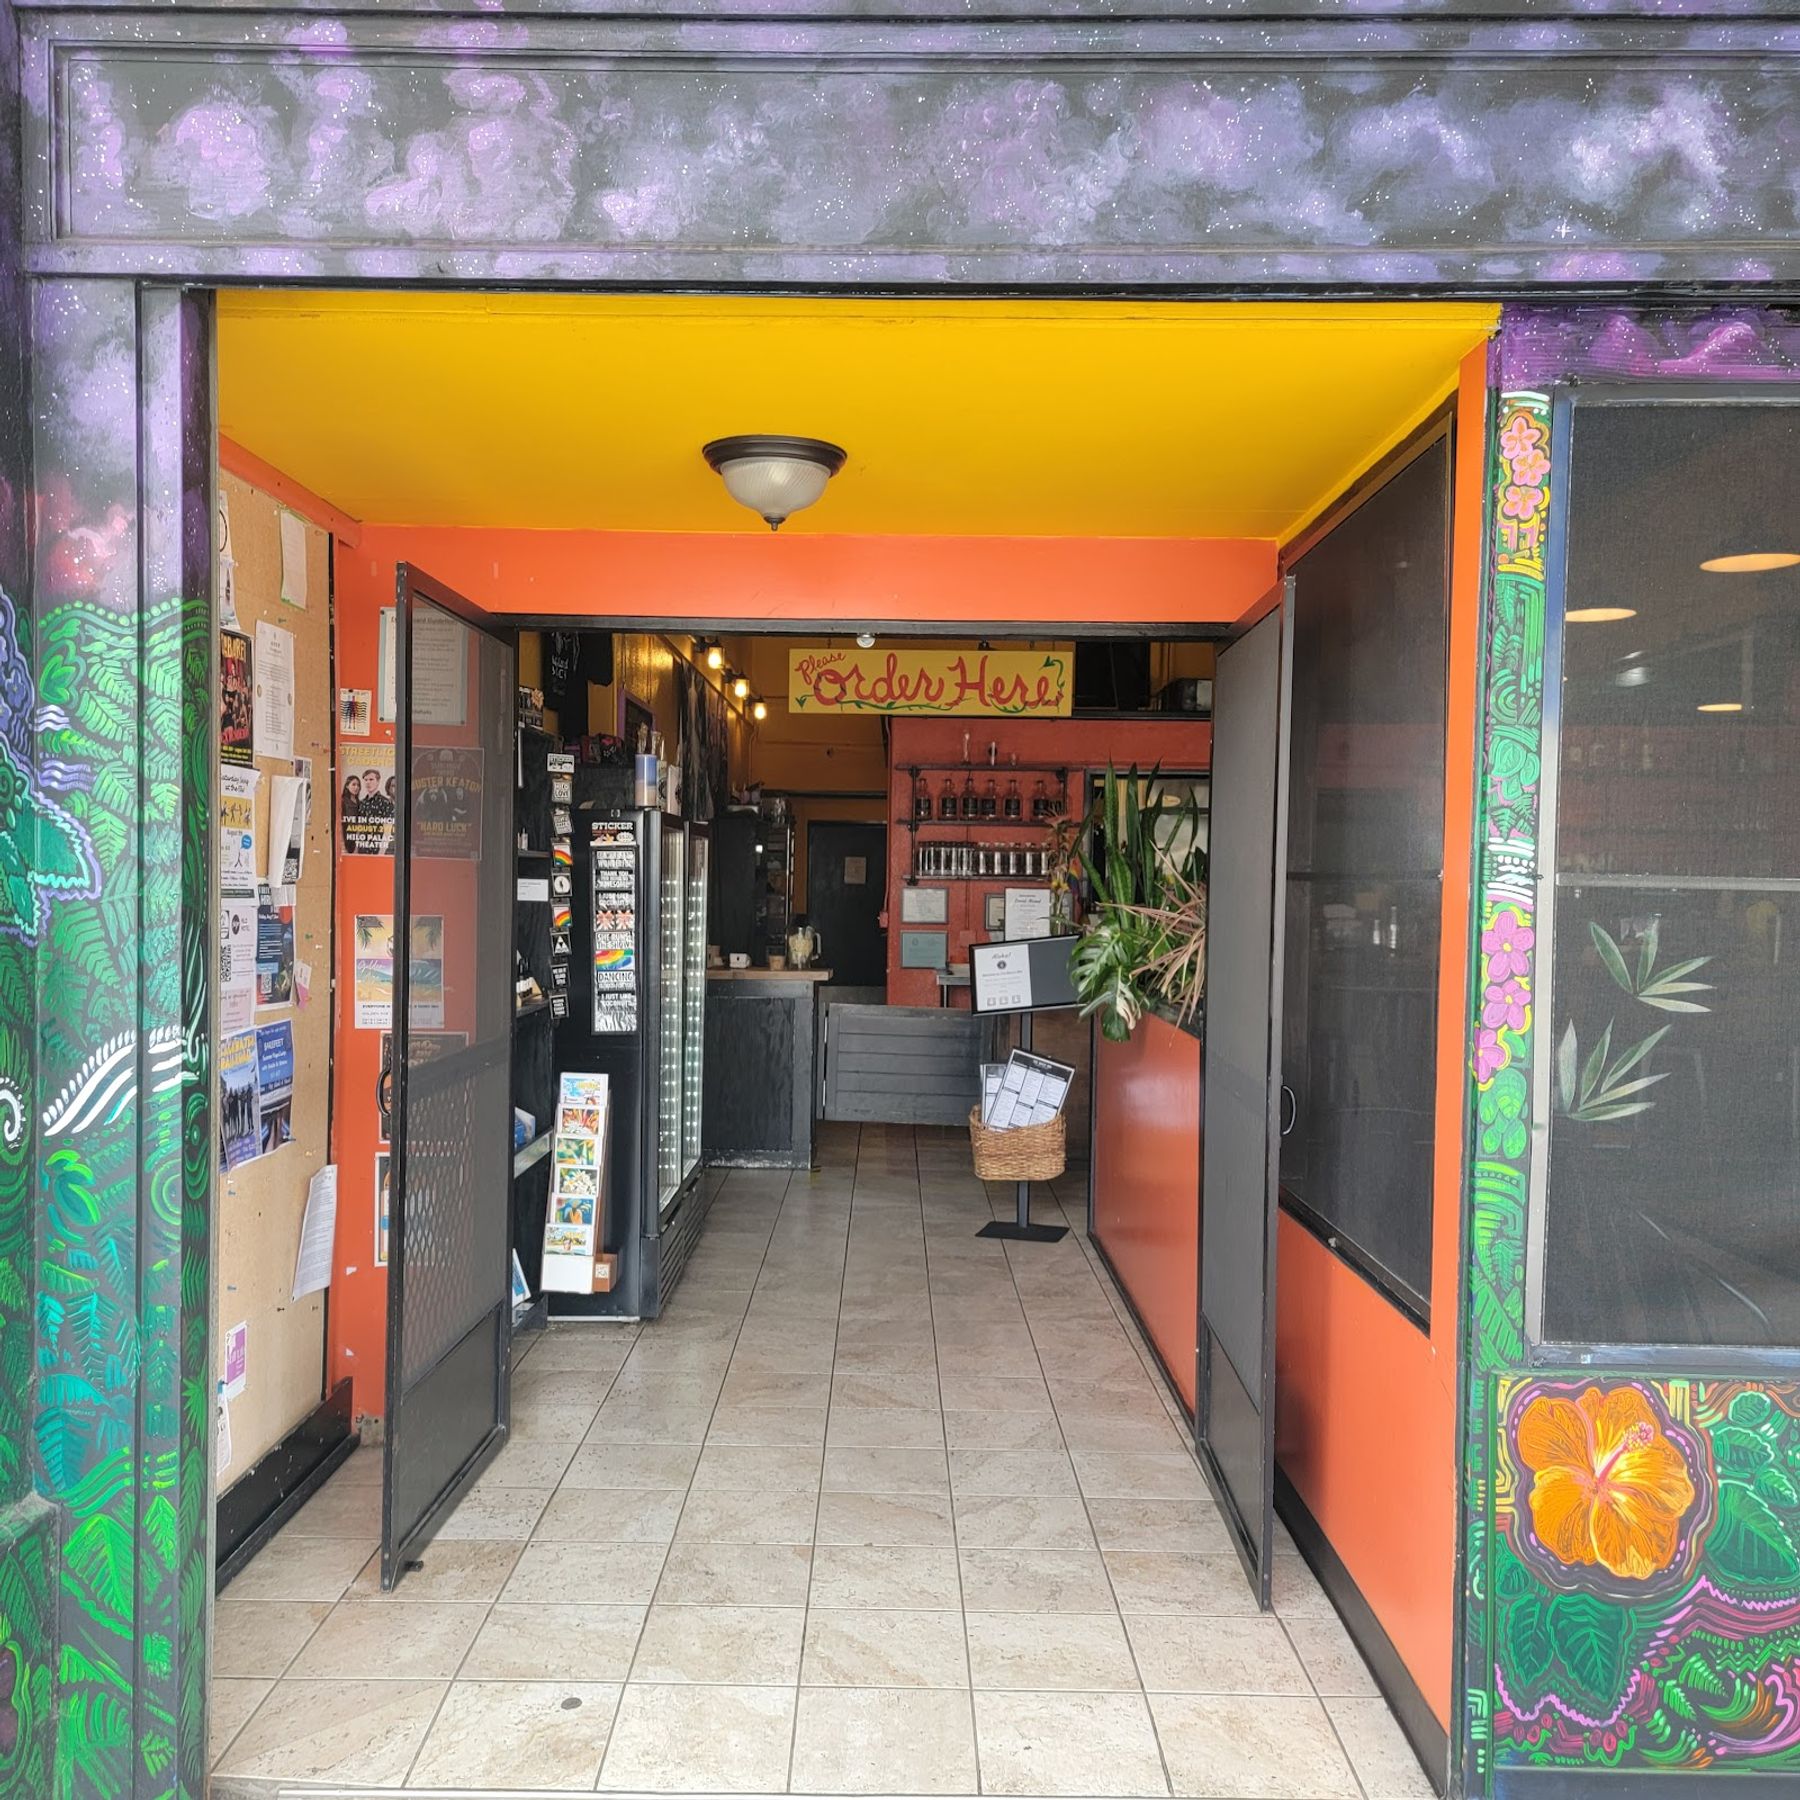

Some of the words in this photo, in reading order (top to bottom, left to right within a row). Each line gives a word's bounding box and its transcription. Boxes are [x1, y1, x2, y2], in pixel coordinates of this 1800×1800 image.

[794, 651, 847, 686] Please
[813, 652, 945, 706] Order
[947, 655, 1062, 707] Here
[340, 747, 395, 756] STREETLIG
[347, 758, 394, 767] CADENC
[368, 816, 395, 824] CONC
[346, 825, 378, 833] AUGUST
[591, 822, 634, 830] STICKER
[346, 833, 366, 841] HILO
[367, 834, 394, 842] PALAC
[354, 841, 389, 849] THEATER
[598, 972, 632, 981] DANCING
